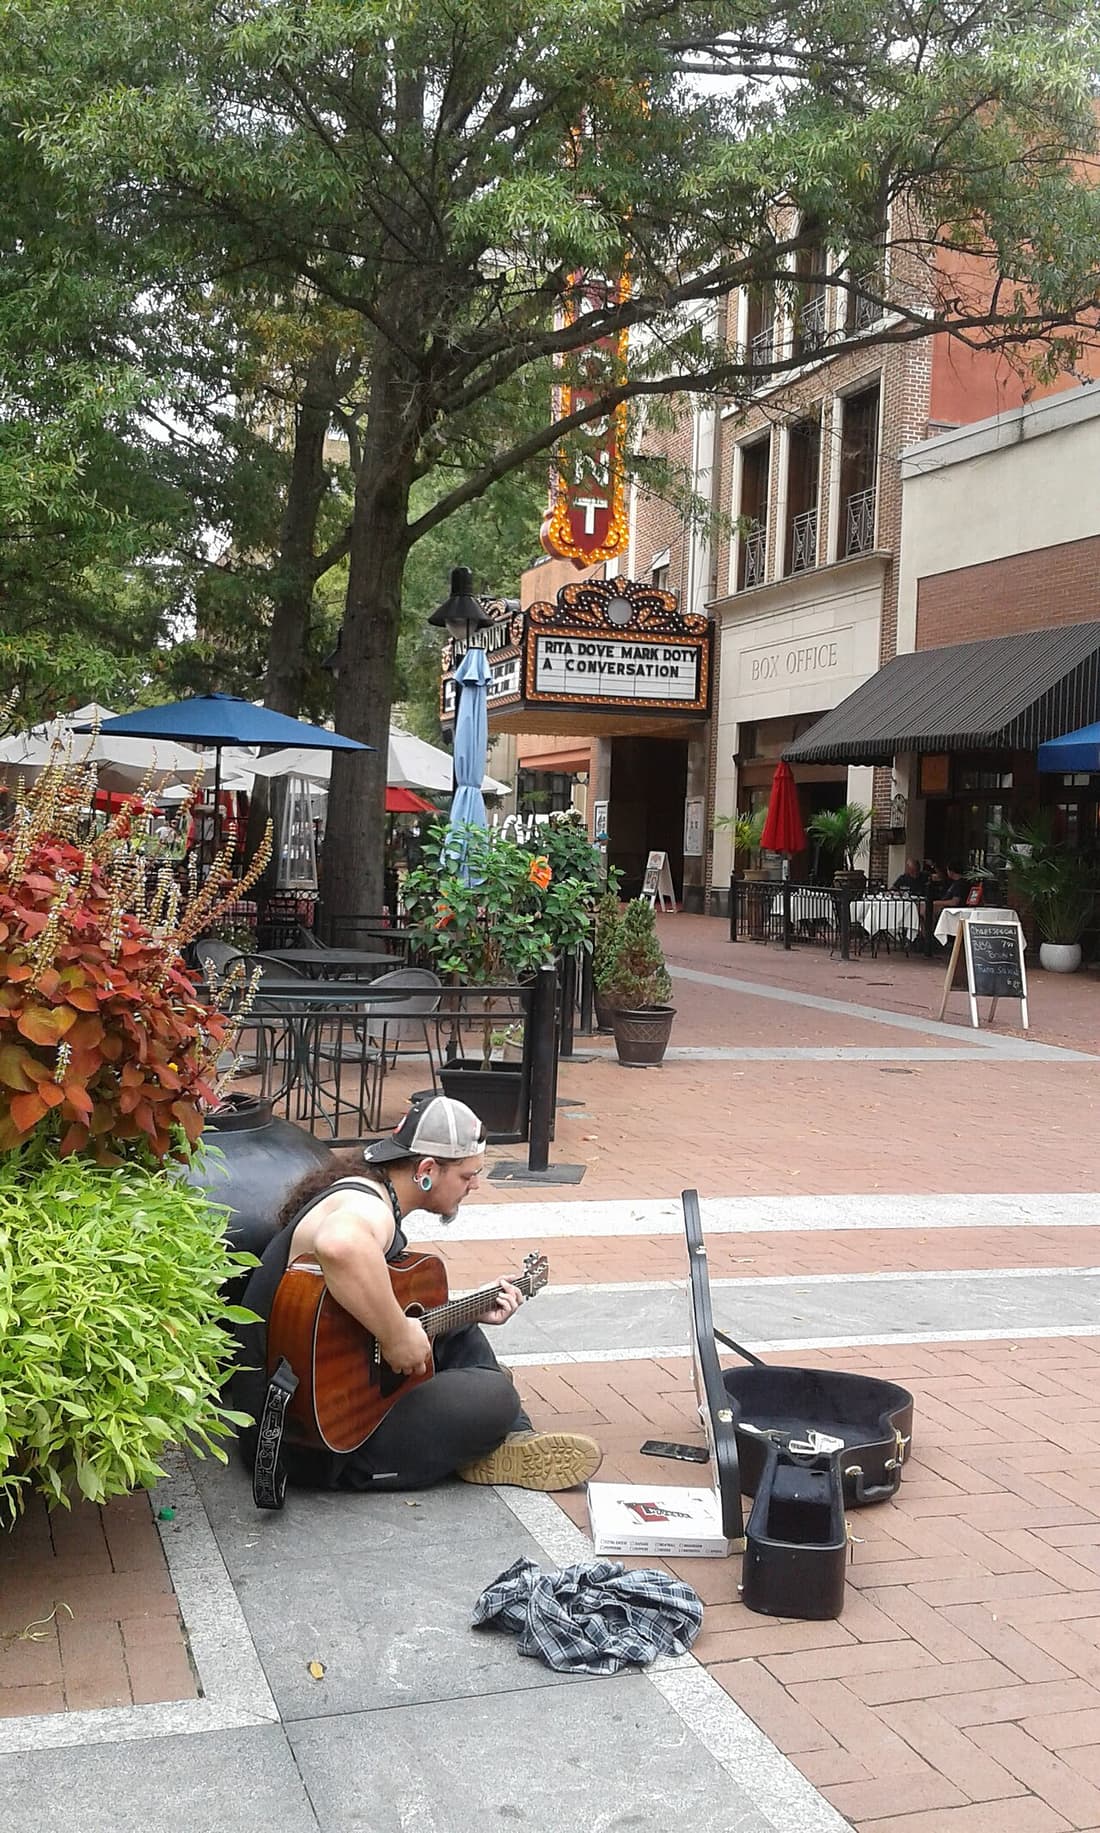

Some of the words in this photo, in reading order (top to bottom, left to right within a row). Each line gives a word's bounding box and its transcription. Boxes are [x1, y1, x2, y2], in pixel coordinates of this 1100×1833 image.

[545, 641, 573, 654] RITA
[578, 643, 614, 658] DOVE
[621, 646, 659, 660] MARK
[664, 649, 697, 663] DOTY
[751, 655, 780, 681] BOX
[786, 643, 838, 674] OFFICE
[543, 658, 552, 671] A
[565, 659, 679, 678] CONVERSATION
